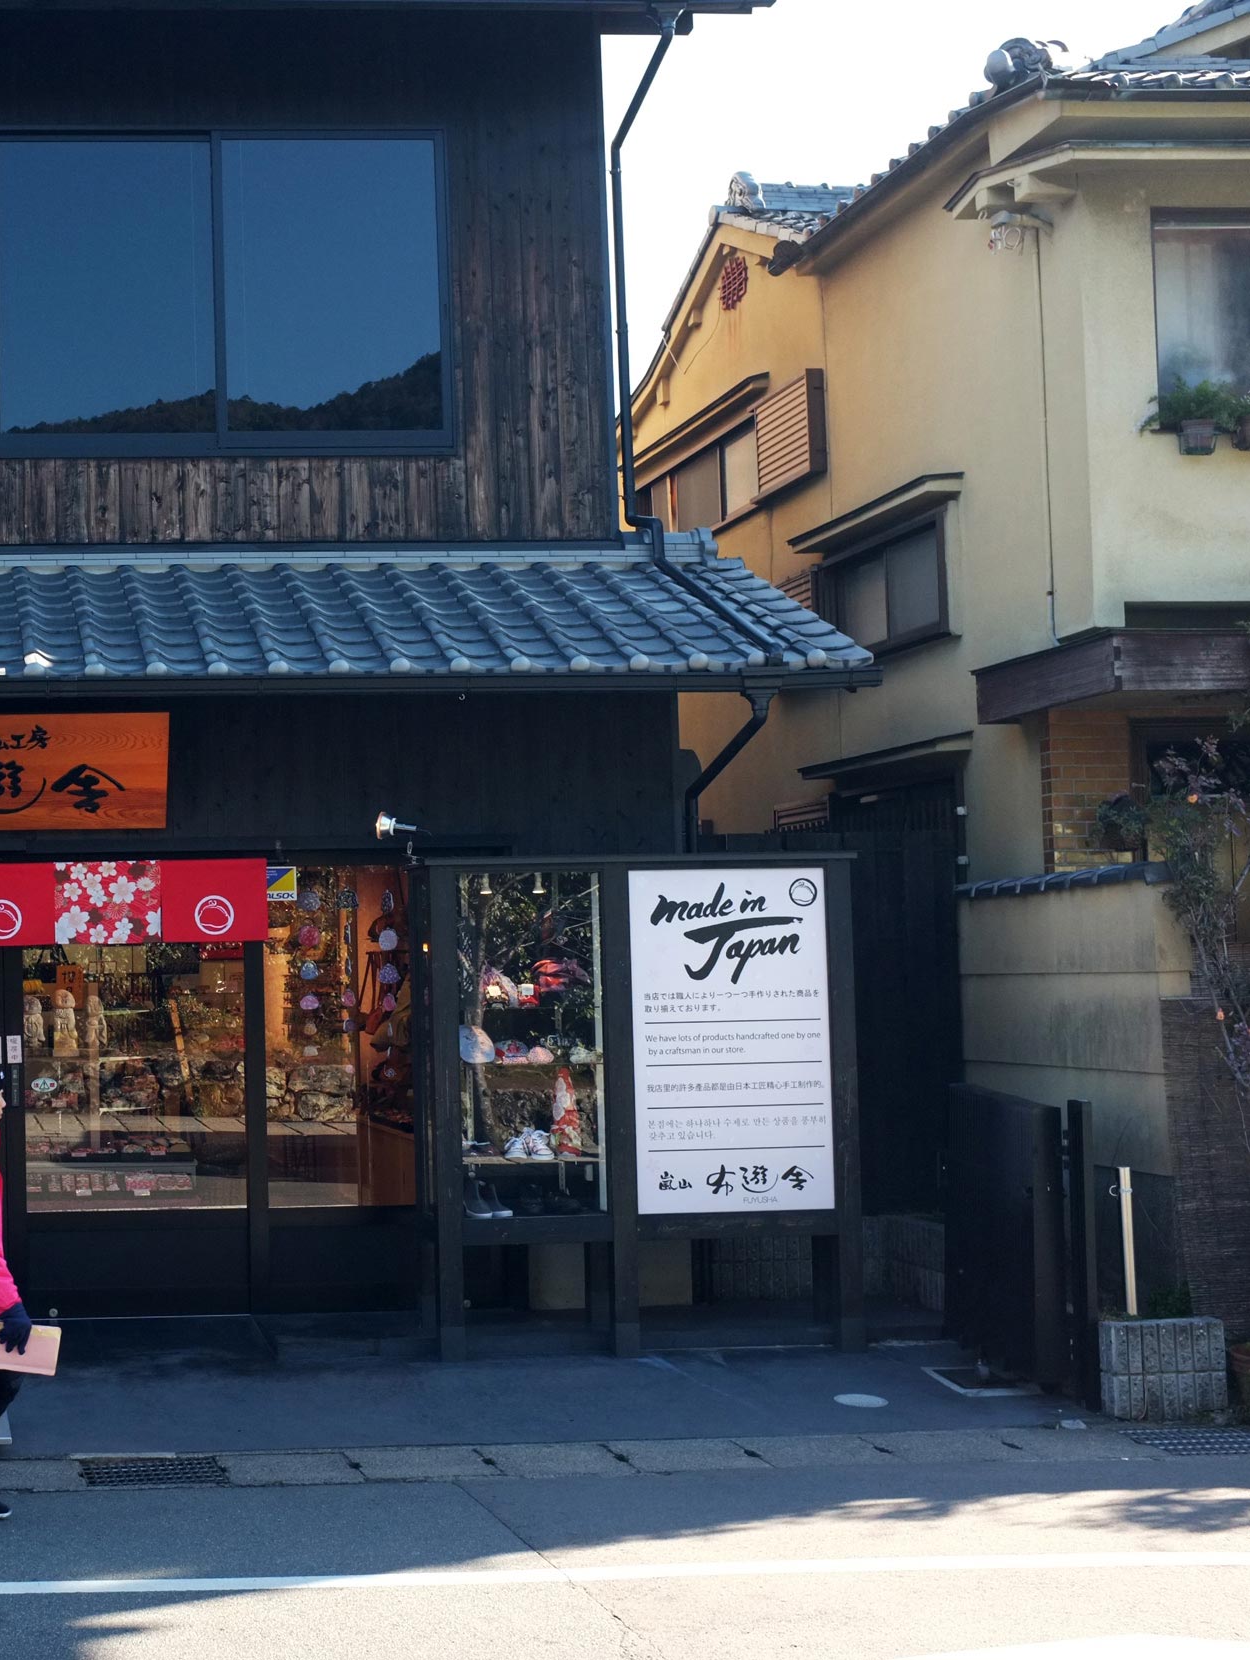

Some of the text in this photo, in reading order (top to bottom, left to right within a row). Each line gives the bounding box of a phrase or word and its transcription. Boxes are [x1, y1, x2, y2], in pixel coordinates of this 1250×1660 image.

[650, 882, 767, 926] made in
[683, 916, 804, 985] Japan
[645, 1031, 821, 1043] We have lots of products handcrafted one by one
[648, 1047, 658, 1057] by
[665, 1046, 701, 1055] craftsman
[658, 1170, 693, 1191] 嵐山
[742, 1196, 778, 1205] FUYUSHA
